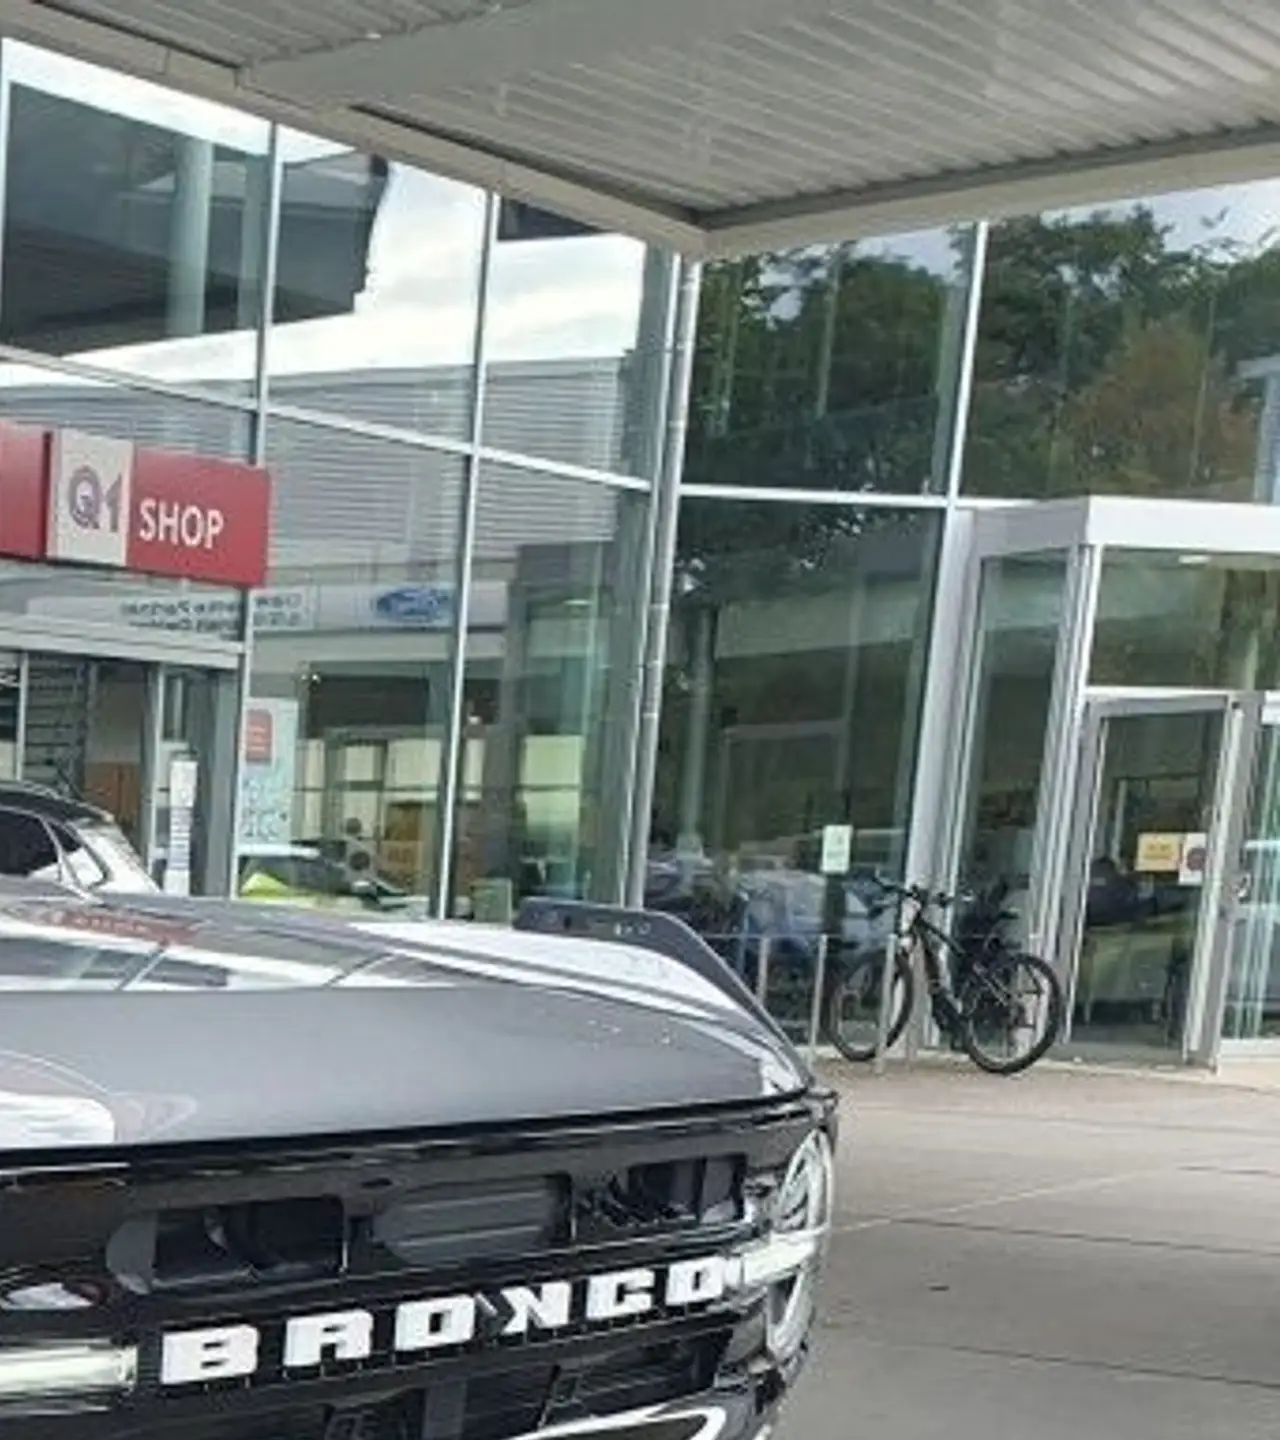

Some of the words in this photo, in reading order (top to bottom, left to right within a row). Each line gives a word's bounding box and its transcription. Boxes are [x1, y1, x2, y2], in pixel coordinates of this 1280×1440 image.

[67, 464, 122, 533] Q1
[139, 497, 225, 549] SHOP
[160, 1256, 728, 1386] BRONCO
